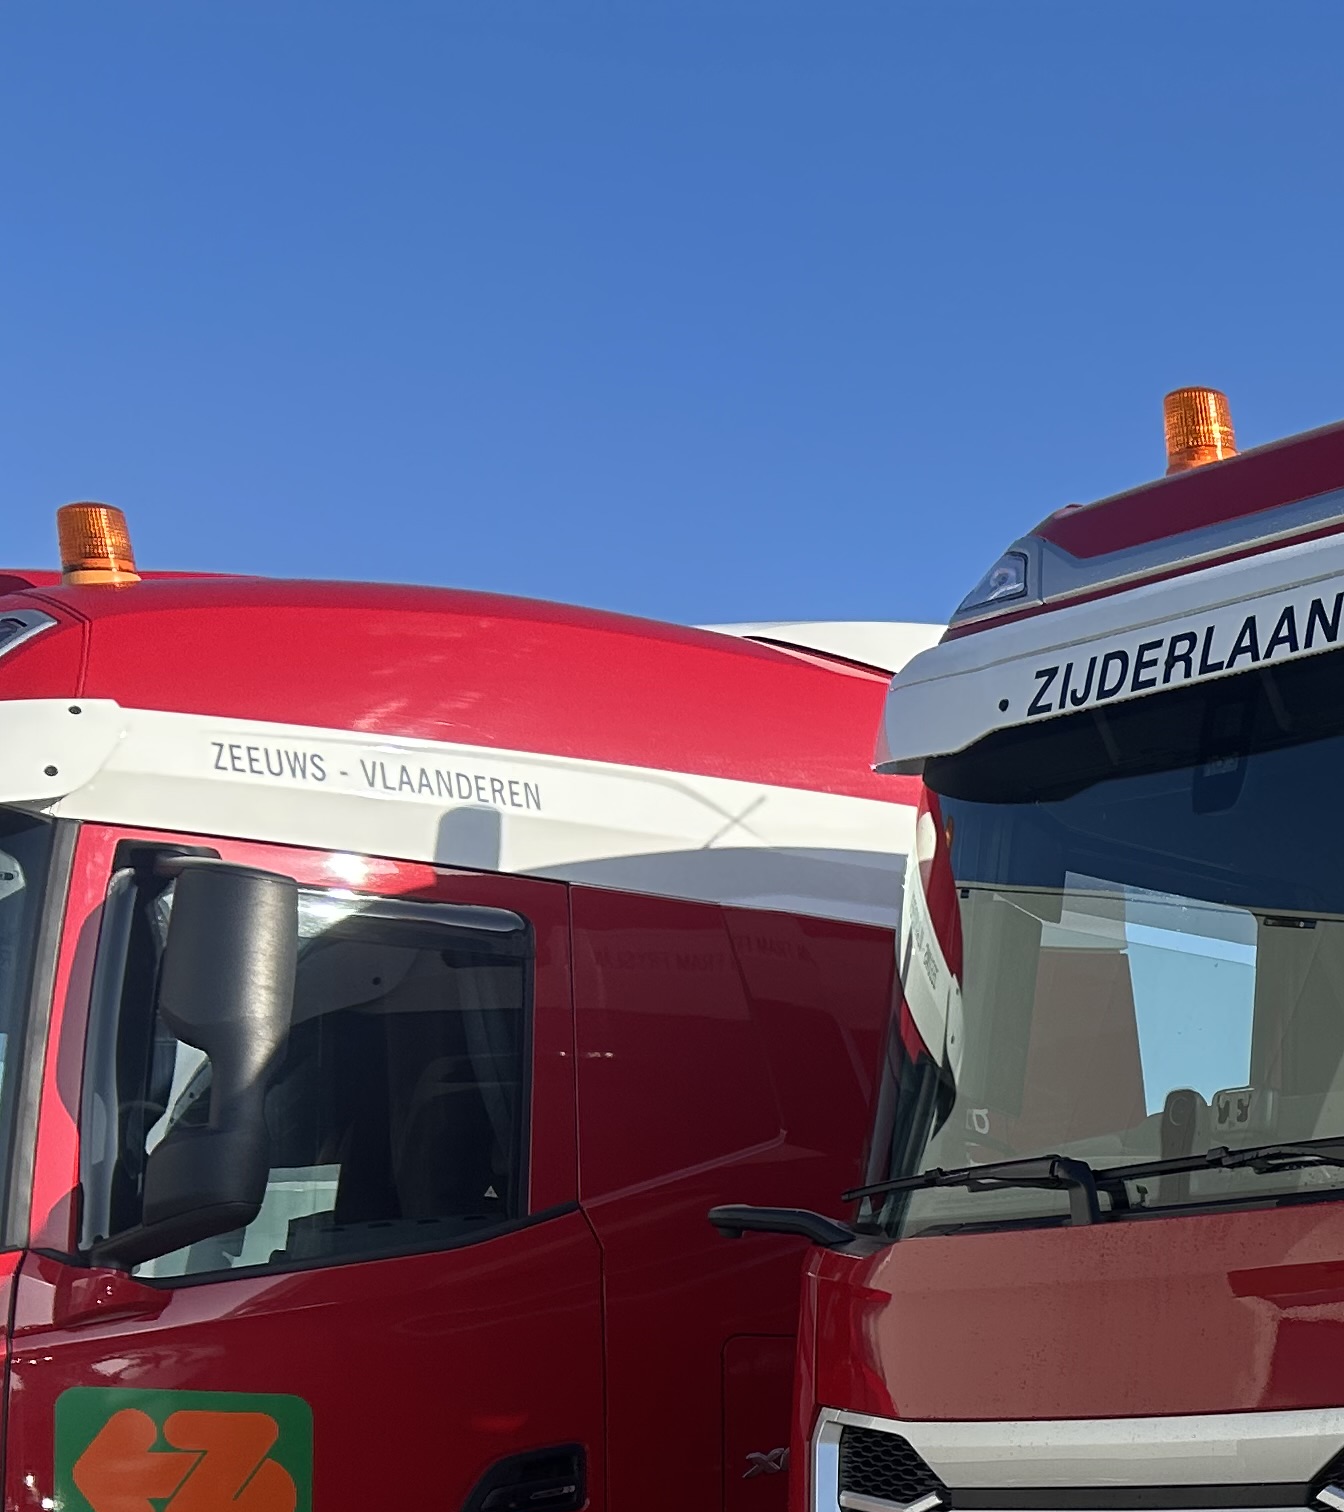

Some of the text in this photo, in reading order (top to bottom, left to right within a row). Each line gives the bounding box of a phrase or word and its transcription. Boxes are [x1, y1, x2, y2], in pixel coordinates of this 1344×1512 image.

[1026, 592, 1344, 717] ZIJDERLAAN
[211, 742, 327, 782] ZEEUWS
[360, 759, 543, 811] VLAANDEREN
